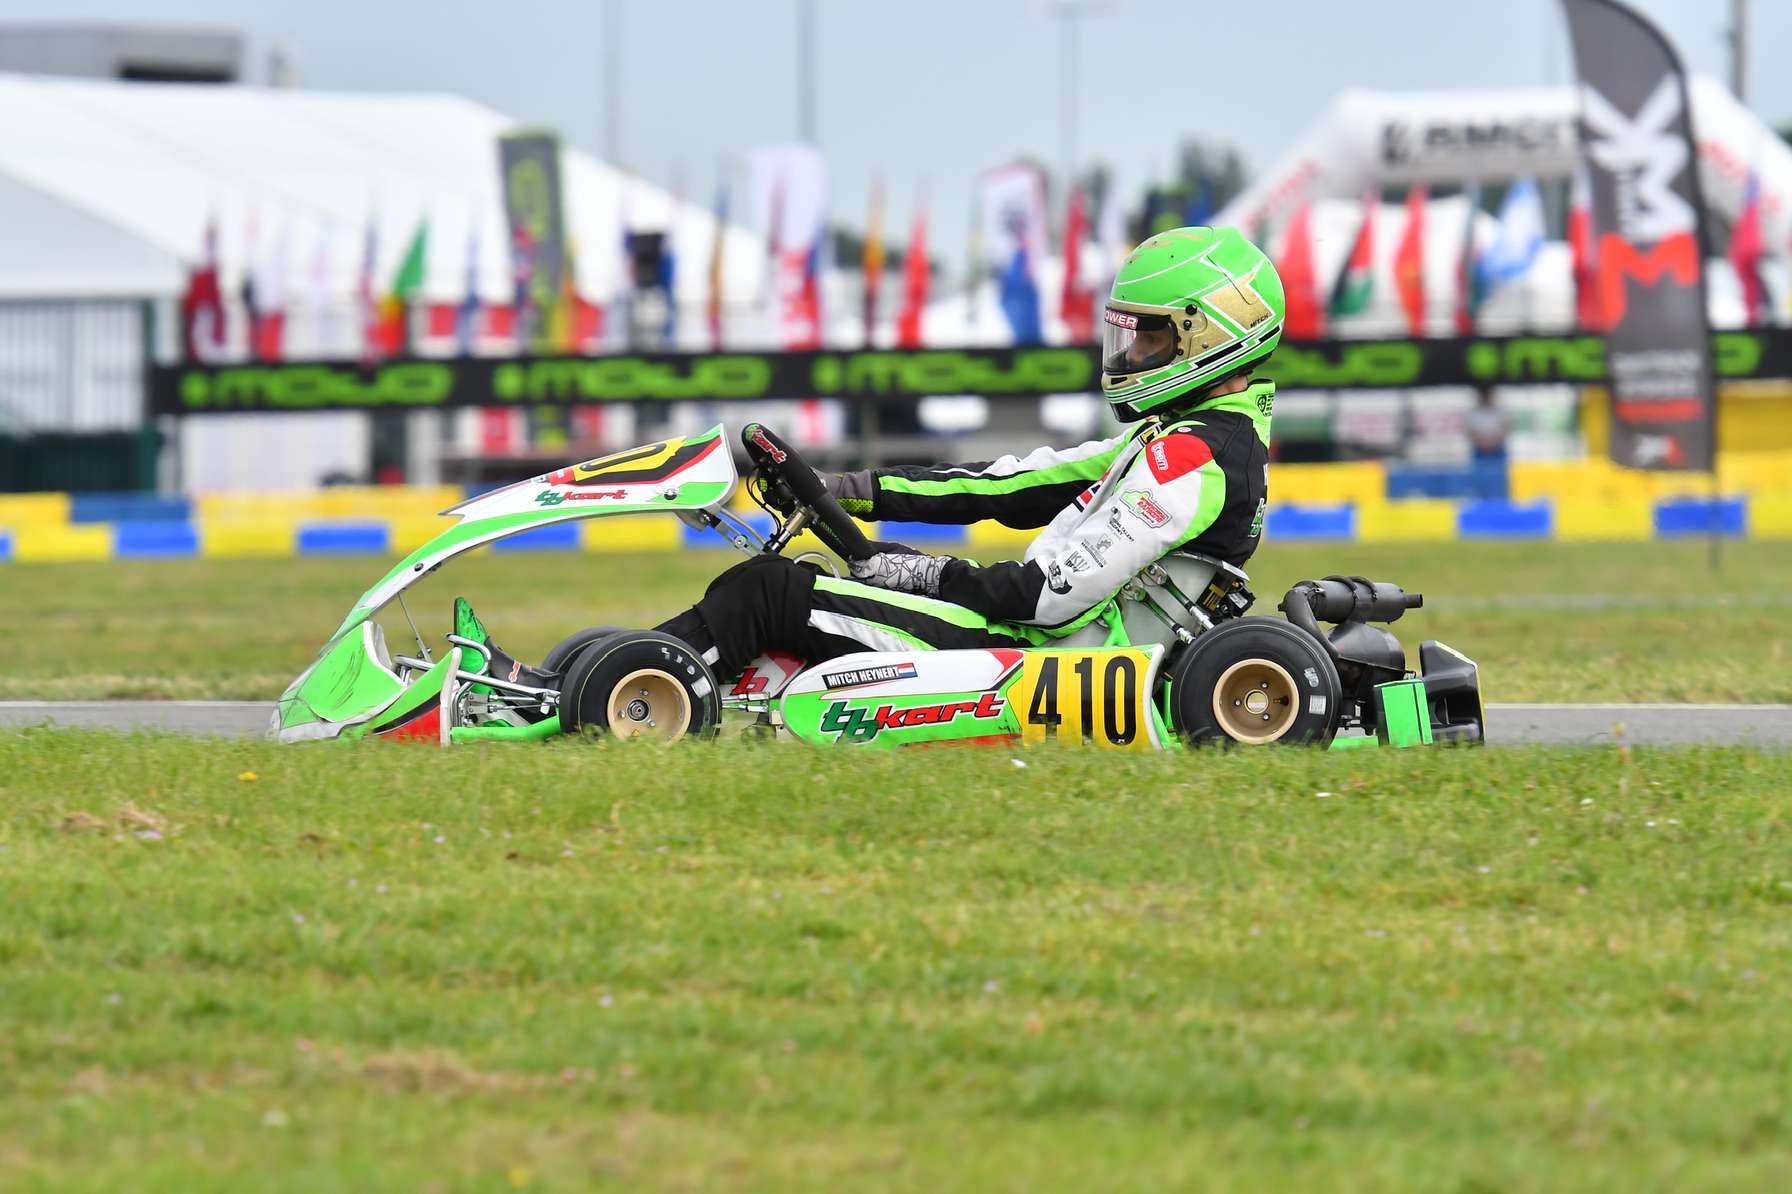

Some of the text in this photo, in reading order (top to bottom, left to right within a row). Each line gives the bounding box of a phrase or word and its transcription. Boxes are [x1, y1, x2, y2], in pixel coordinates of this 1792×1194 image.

[826, 666, 900, 687] MITCH HEYNERT
[1028, 656, 1137, 746] 410
[820, 692, 1005, 745] tbkart
